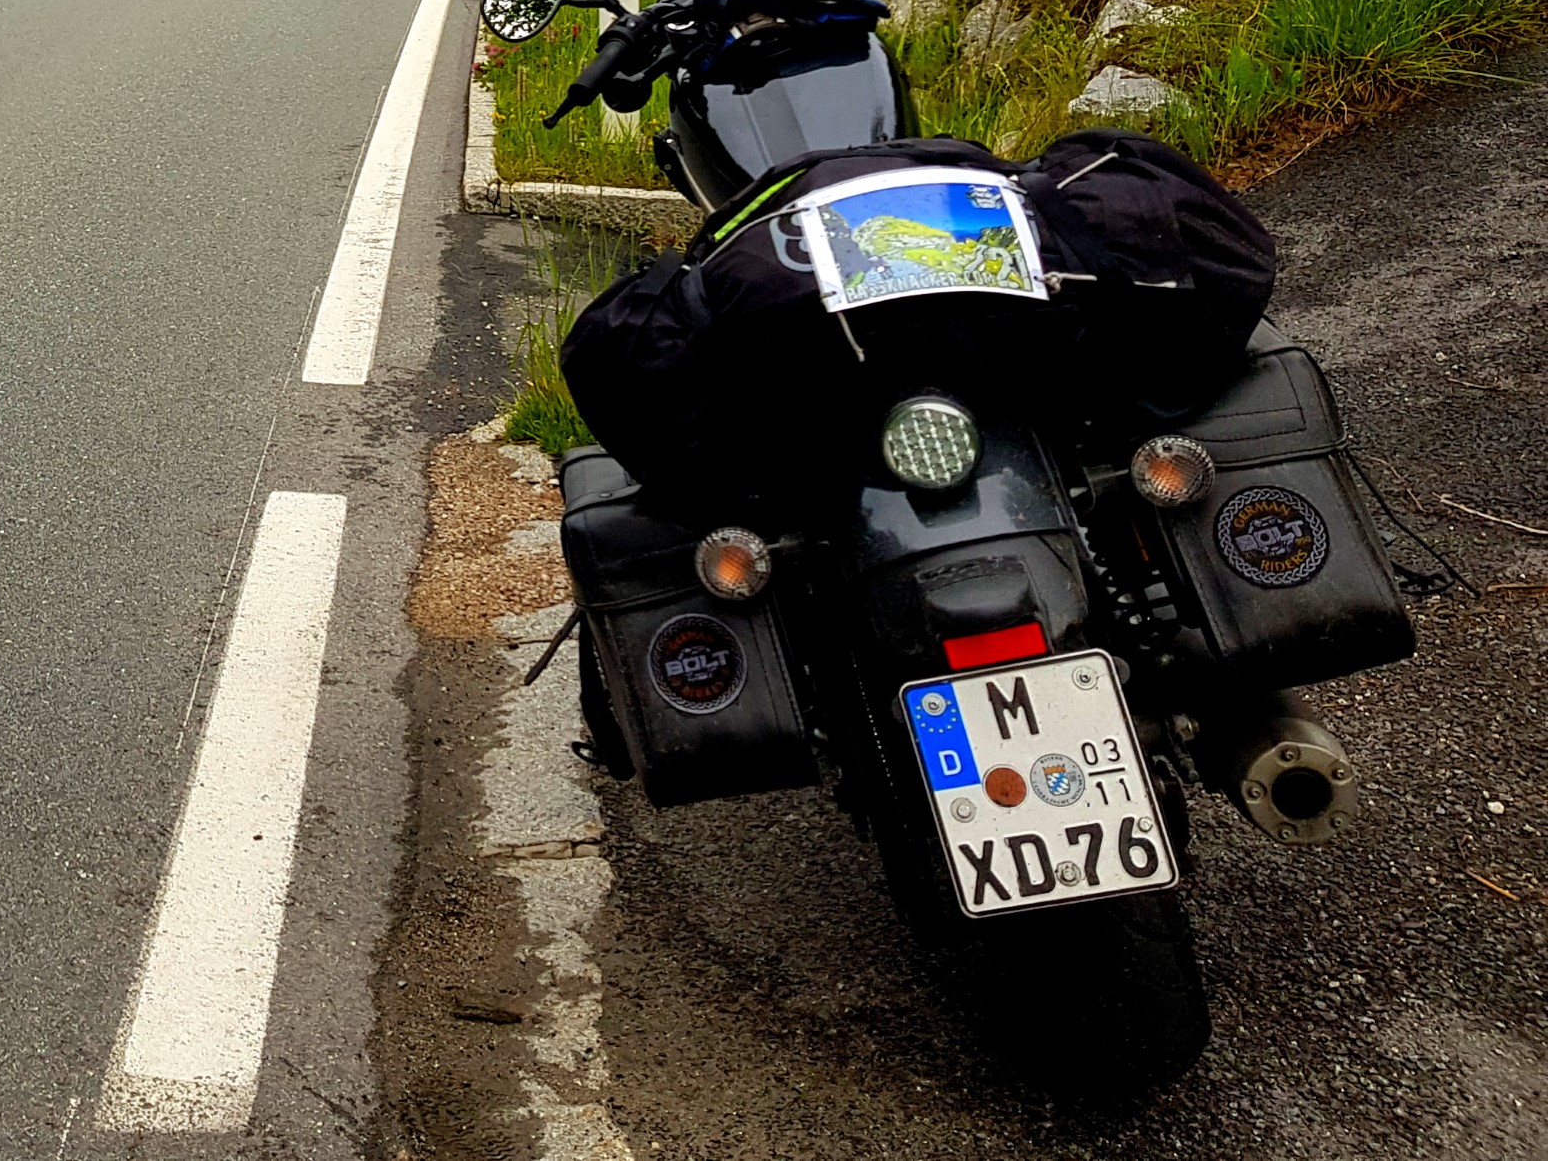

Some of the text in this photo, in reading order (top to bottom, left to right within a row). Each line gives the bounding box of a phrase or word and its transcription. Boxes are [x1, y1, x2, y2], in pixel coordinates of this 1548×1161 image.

[1233, 501, 1291, 528] GERMAN
[1235, 520, 1304, 552] BOLT
[1260, 549, 1308, 572] RIDERS
[665, 650, 730, 677] BOLT
[985, 676, 1040, 740] M
[938, 749, 962, 776] D
[1080, 738, 1121, 766] 03
[1095, 777, 1131, 806] 11
